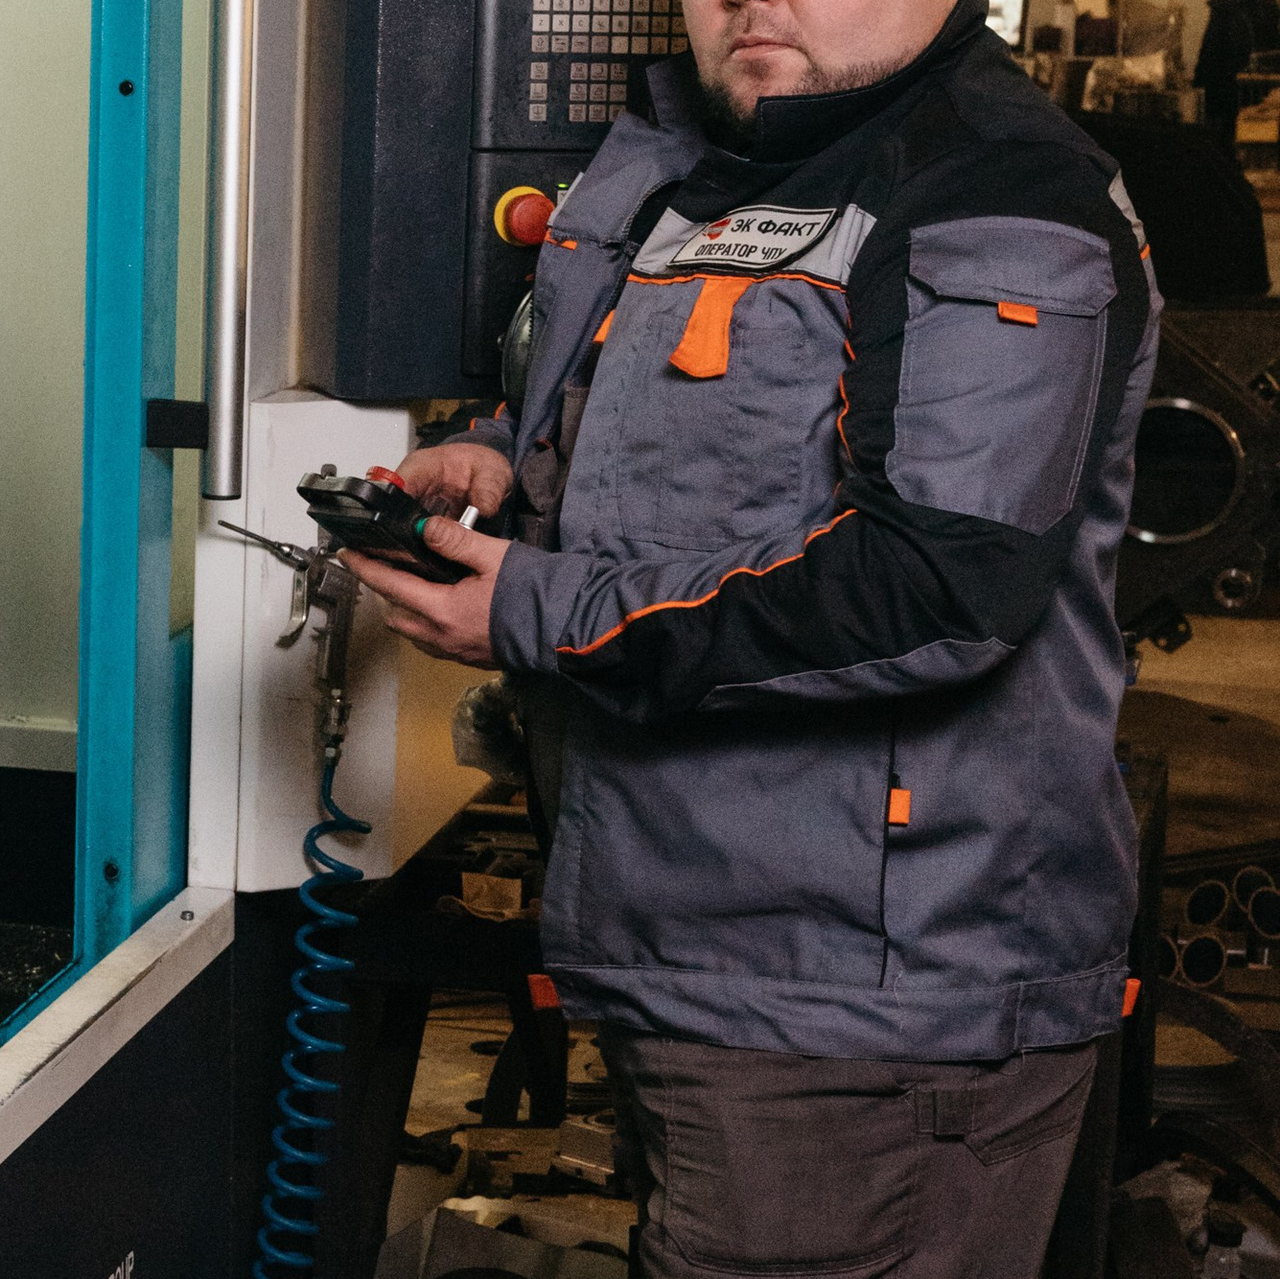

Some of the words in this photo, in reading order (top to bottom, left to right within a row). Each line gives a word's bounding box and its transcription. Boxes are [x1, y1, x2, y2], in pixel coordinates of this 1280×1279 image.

[730, 218, 757, 232] ЭК
[757, 219, 821, 236] ФАКТ
[694, 243, 758, 258] ОПЕРАТОР
[761, 246, 788, 260] ЧПУ
